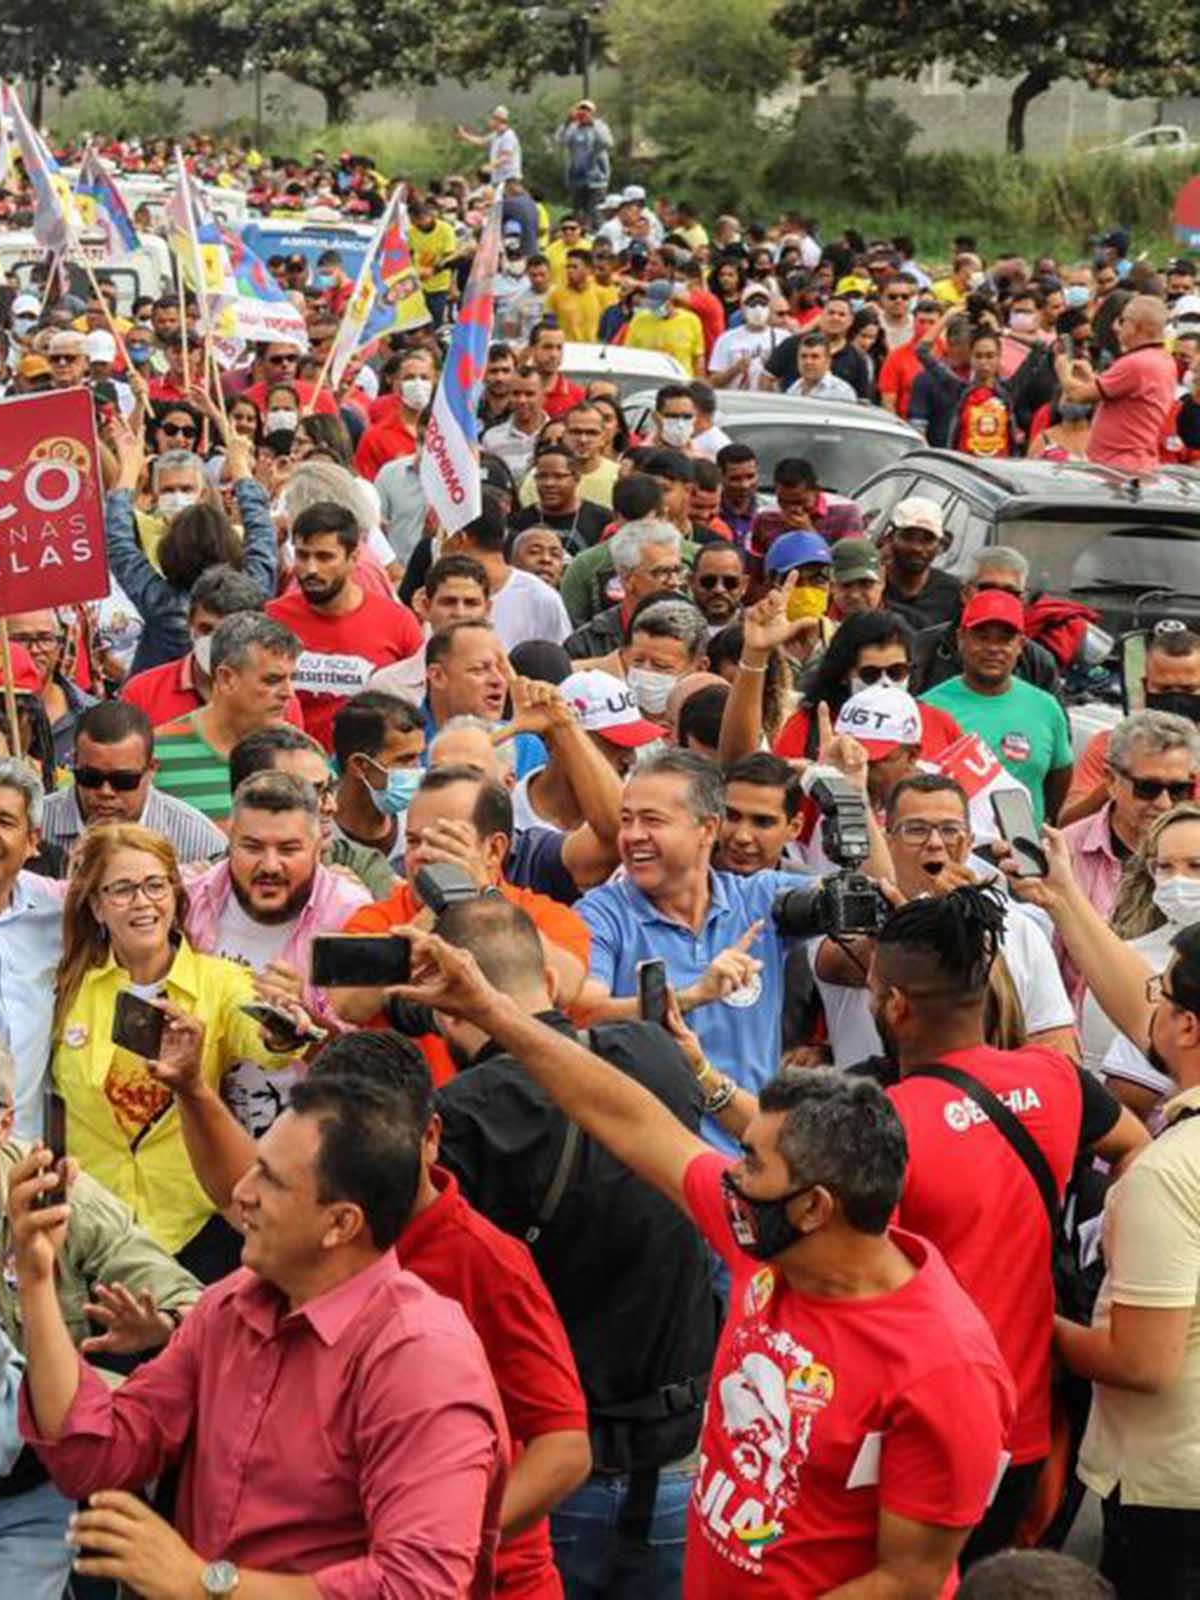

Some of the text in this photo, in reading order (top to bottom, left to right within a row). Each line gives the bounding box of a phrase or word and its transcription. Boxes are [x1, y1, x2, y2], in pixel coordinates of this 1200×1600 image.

[9, 513, 88, 545] NAS
[840, 706, 891, 729] UGT
[962, 1086, 1042, 1125] BHIA
